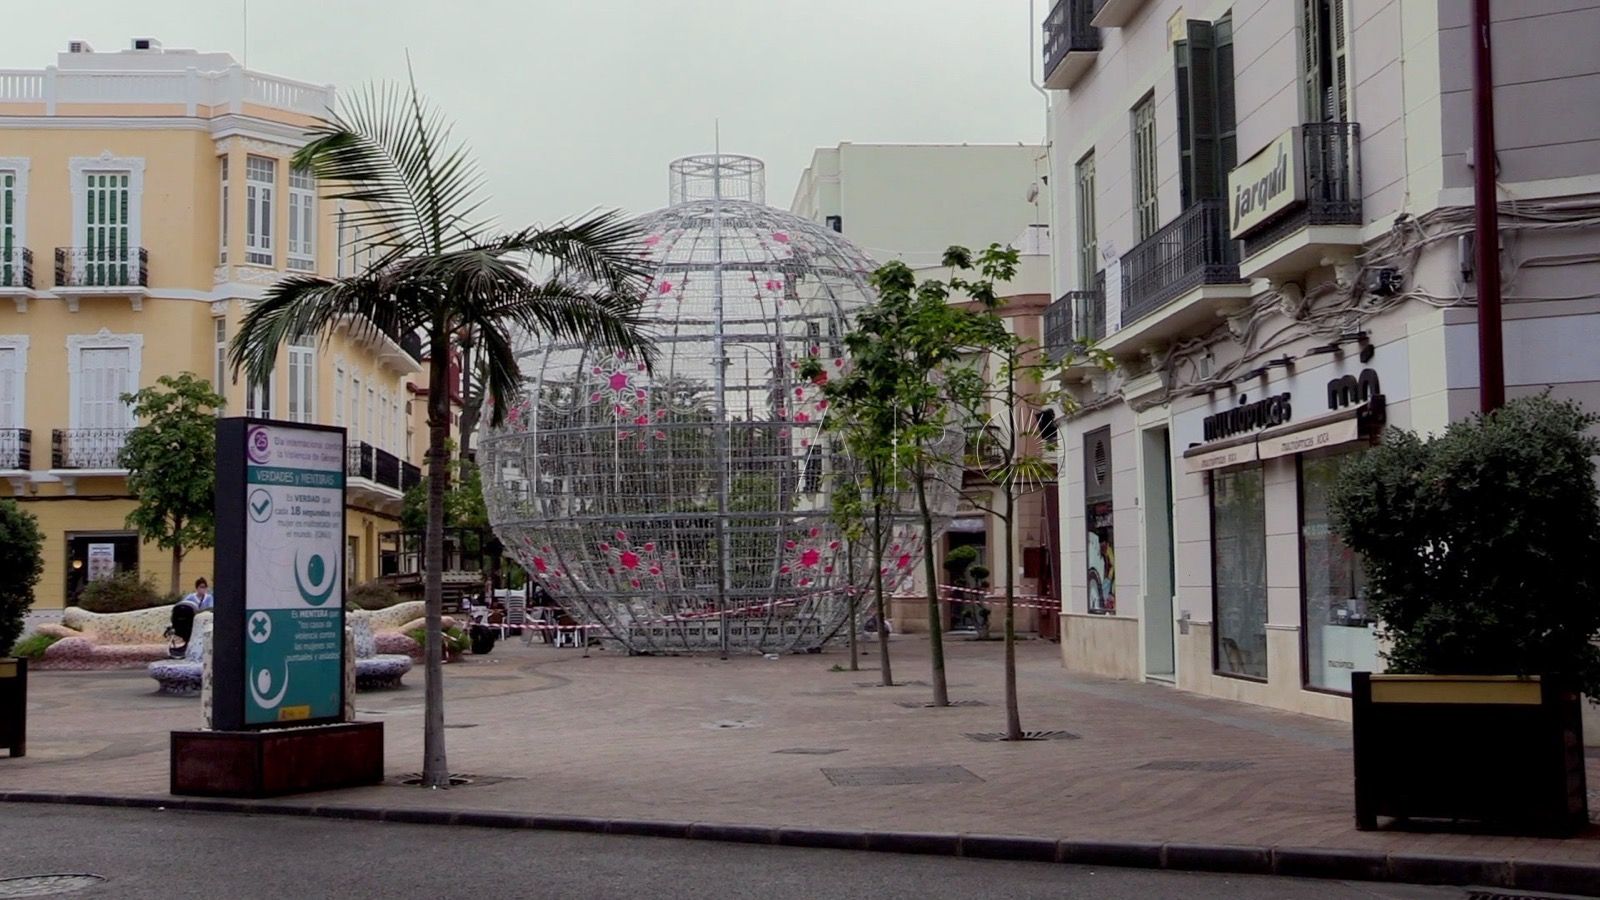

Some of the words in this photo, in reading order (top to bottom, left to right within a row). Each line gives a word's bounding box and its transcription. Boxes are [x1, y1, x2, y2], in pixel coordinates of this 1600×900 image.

[256, 470, 294, 483] VERDADES
[301, 473, 335, 486] MENTIRAS
[294, 494, 320, 503] VERDAD
[291, 506, 301, 516] 18
